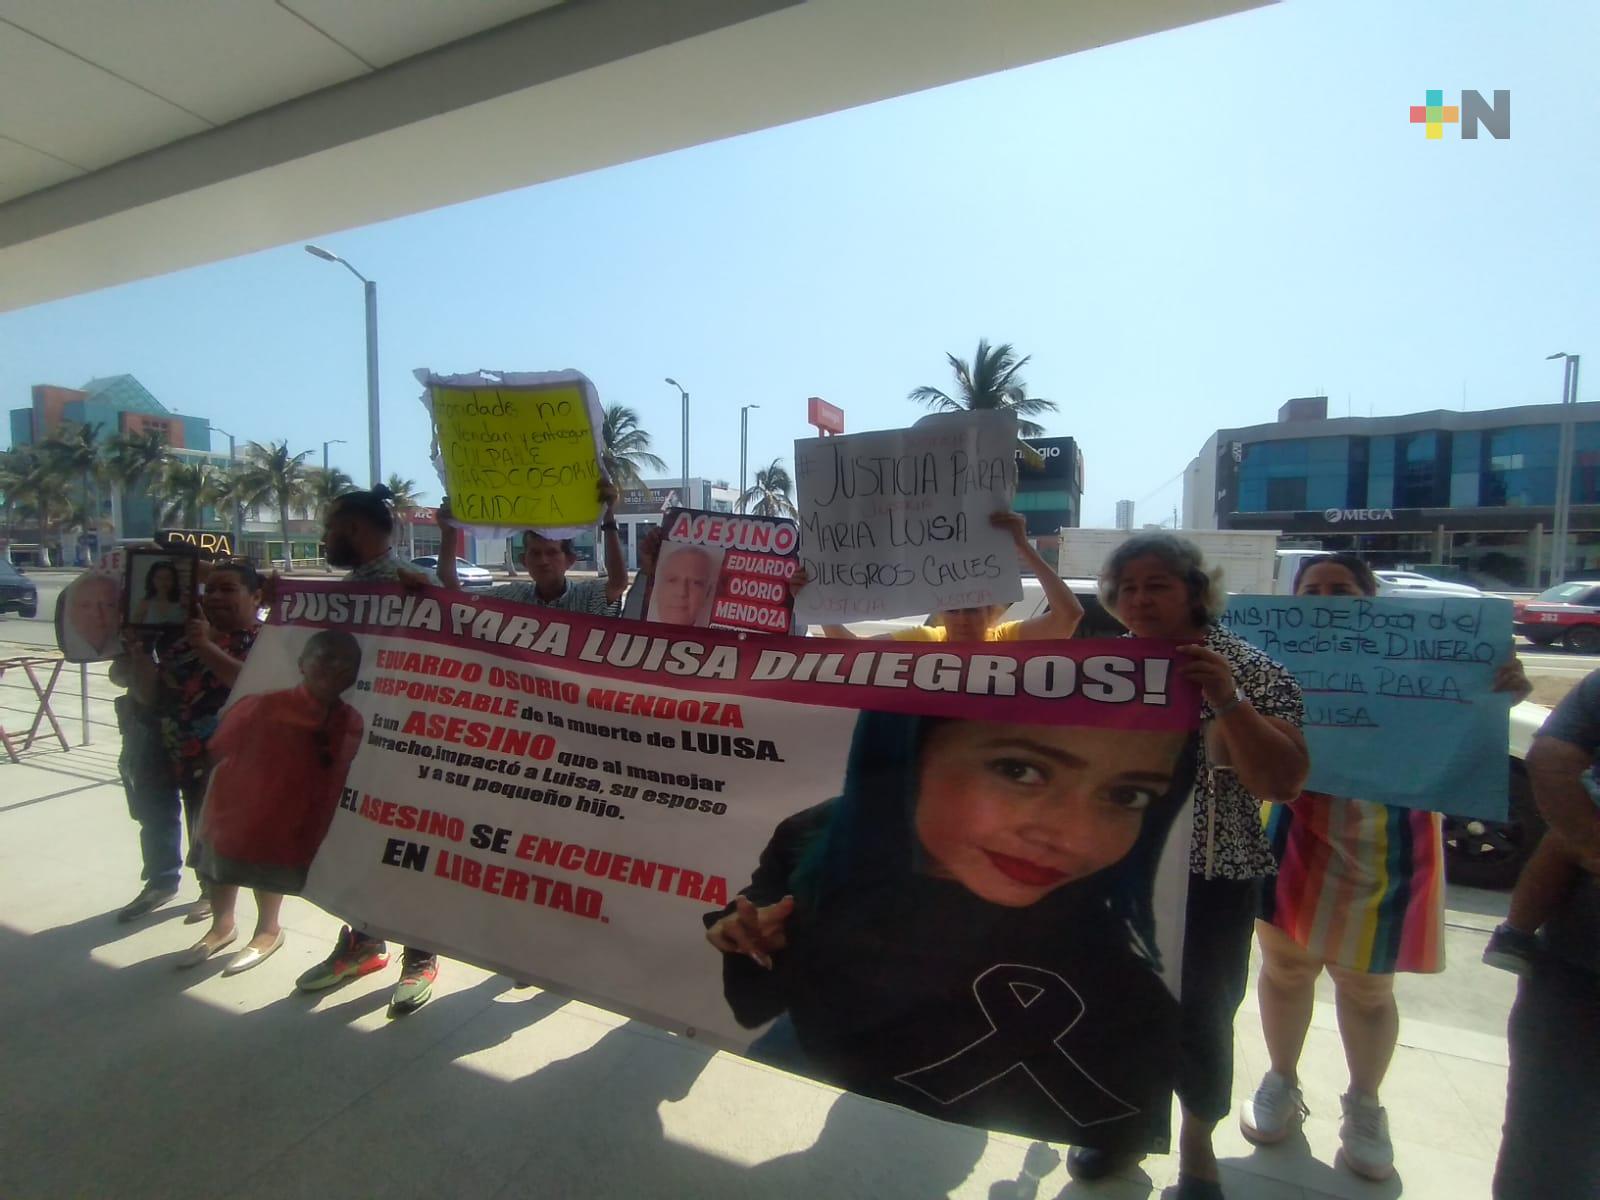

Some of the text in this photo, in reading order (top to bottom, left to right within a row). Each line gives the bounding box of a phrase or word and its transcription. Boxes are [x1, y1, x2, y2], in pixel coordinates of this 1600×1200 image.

[535, 400, 571, 420] no
[669, 512, 797, 554] ASESINO
[800, 507, 967, 552] MARIA LUISA
[1342, 508, 1393, 521] MEGA
[726, 554, 796, 578] EDUARDO
[730, 579, 783, 602] OSORIO
[715, 600, 786, 628] MENDOZA
[1219, 606, 1303, 630] ANSITO
[1311, 607, 1350, 630] DE
[1428, 600, 1483, 640] del
[450, 602, 570, 656] PARA
[588, 627, 738, 680] LUISA
[749, 650, 1170, 705] DILIEGROS!
[1384, 631, 1495, 661] DINERO
[376, 649, 744, 729] EDUARDO OSORIO MENDOZA
[1290, 666, 1461, 699] TICIA PARA
[373, 676, 519, 718] RESPONSABLE
[521, 705, 544, 723] de
[547, 711, 564, 728] la
[567, 718, 642, 744] muerte
[647, 732, 676, 749] de
[682, 730, 785, 763] LUISA.
[1304, 704, 1372, 725] UISA
[401, 711, 557, 761] ASESINO
[558, 750, 598, 771] que
[603, 760, 622, 776] al
[627, 765, 726, 794] manejar
[445, 771, 469, 788] su
[473, 778, 572, 809] pequeño
[575, 800, 625, 820] hijo.
[524, 766, 538, 780] a
[542, 766, 604, 794] Luisa,
[609, 782, 638, 800] su
[642, 788, 728, 816] esposo
[340, 786, 728, 907] EL ASESINO SE ENCUENTRA
[381, 837, 610, 924] EN LIBERTAD.
